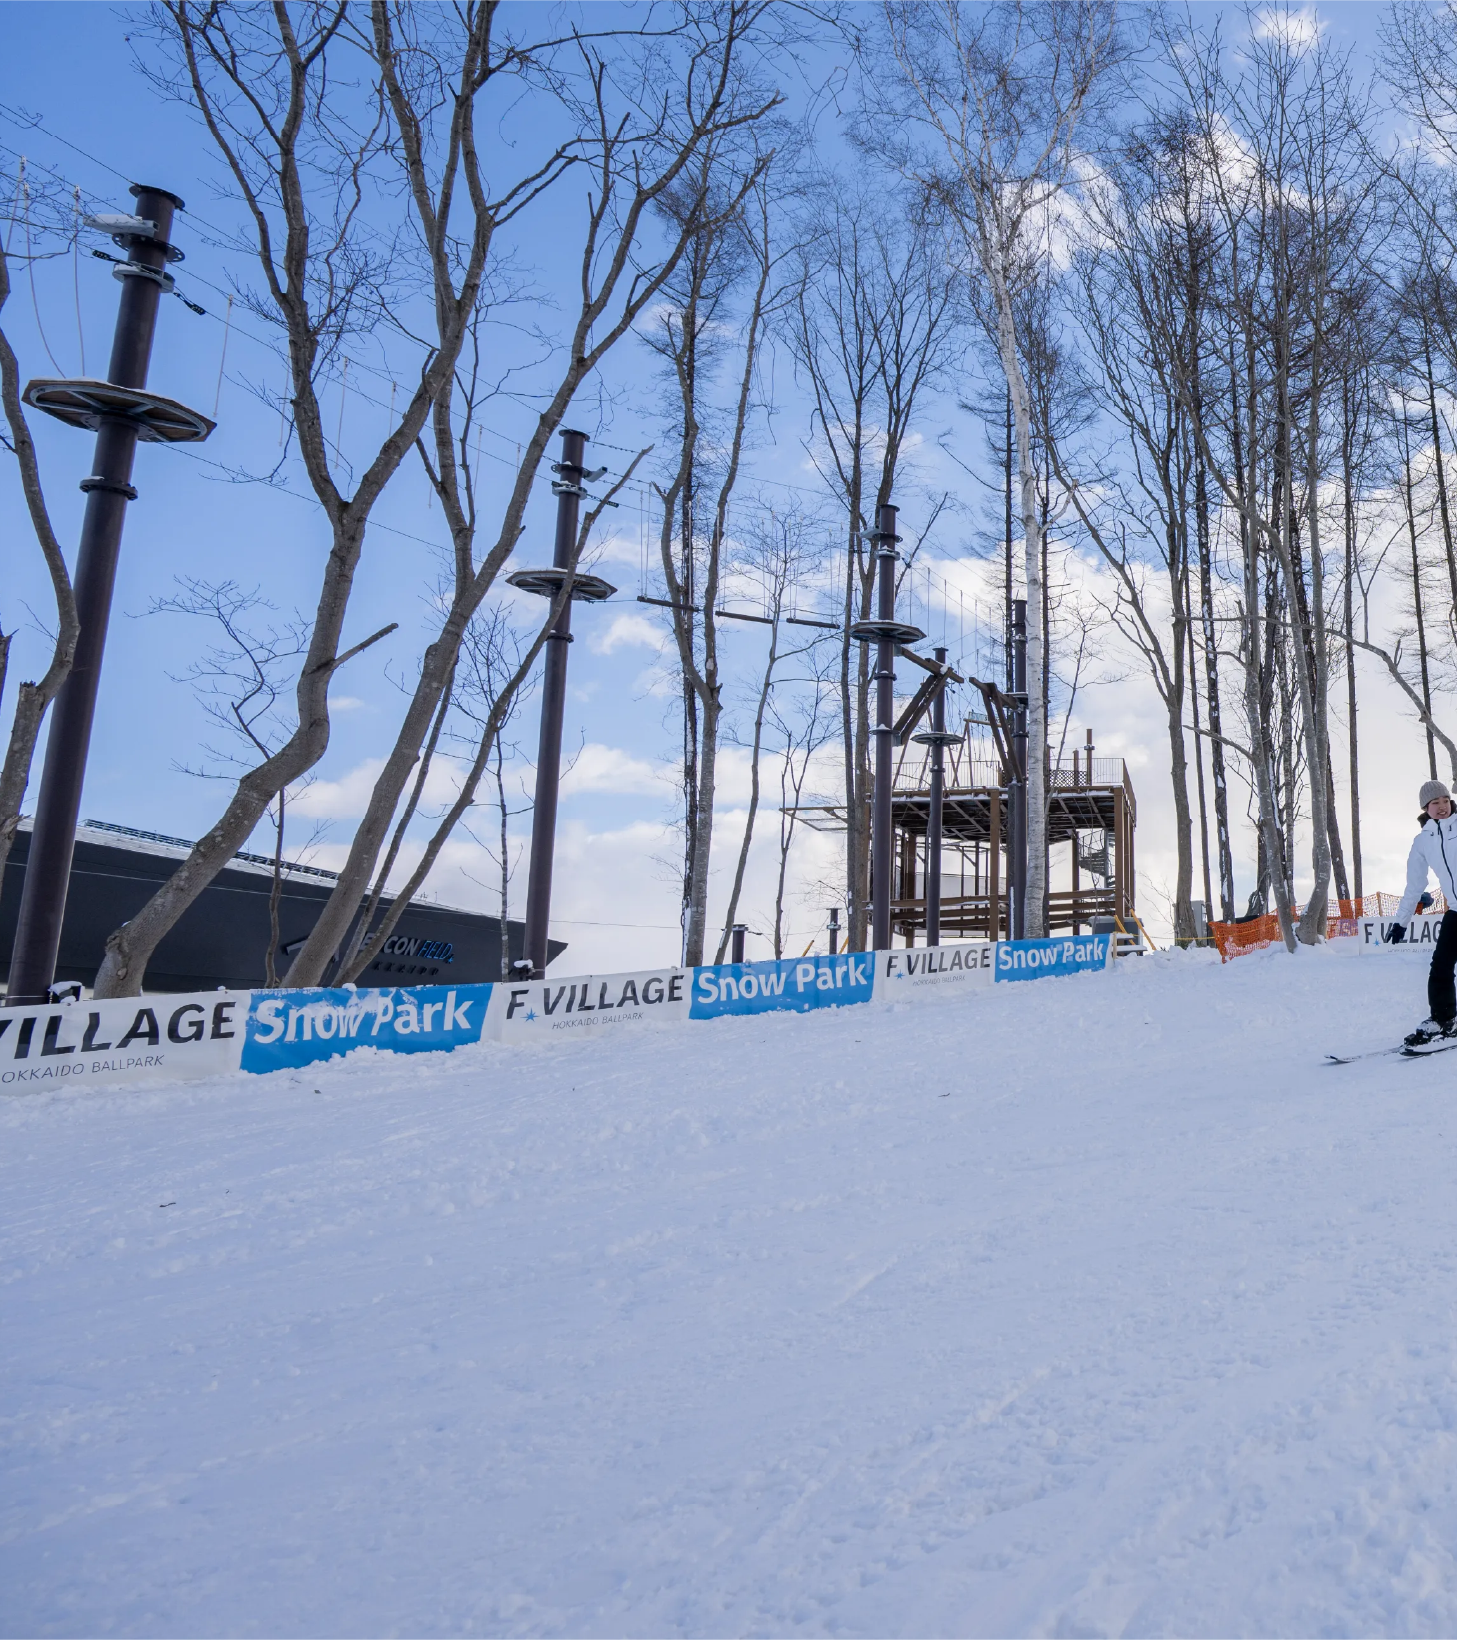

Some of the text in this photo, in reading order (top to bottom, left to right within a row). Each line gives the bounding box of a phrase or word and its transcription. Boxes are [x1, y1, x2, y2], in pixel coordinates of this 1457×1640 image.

[360, 932, 453, 960] ECON FIELD
[1364, 923, 1374, 943] F
[886, 948, 991, 978] F VILLAGE
[998, 938, 1104, 970] Snow Park
[697, 957, 868, 1004] Snow Park
[506, 975, 685, 1020] F VILLAGE
[253, 991, 474, 1044] Snow Park
[551, 1011, 645, 1030] HOKKAIDO BALLPARK
[0, 1054, 165, 1084] OKKAIDO BALLPARK
